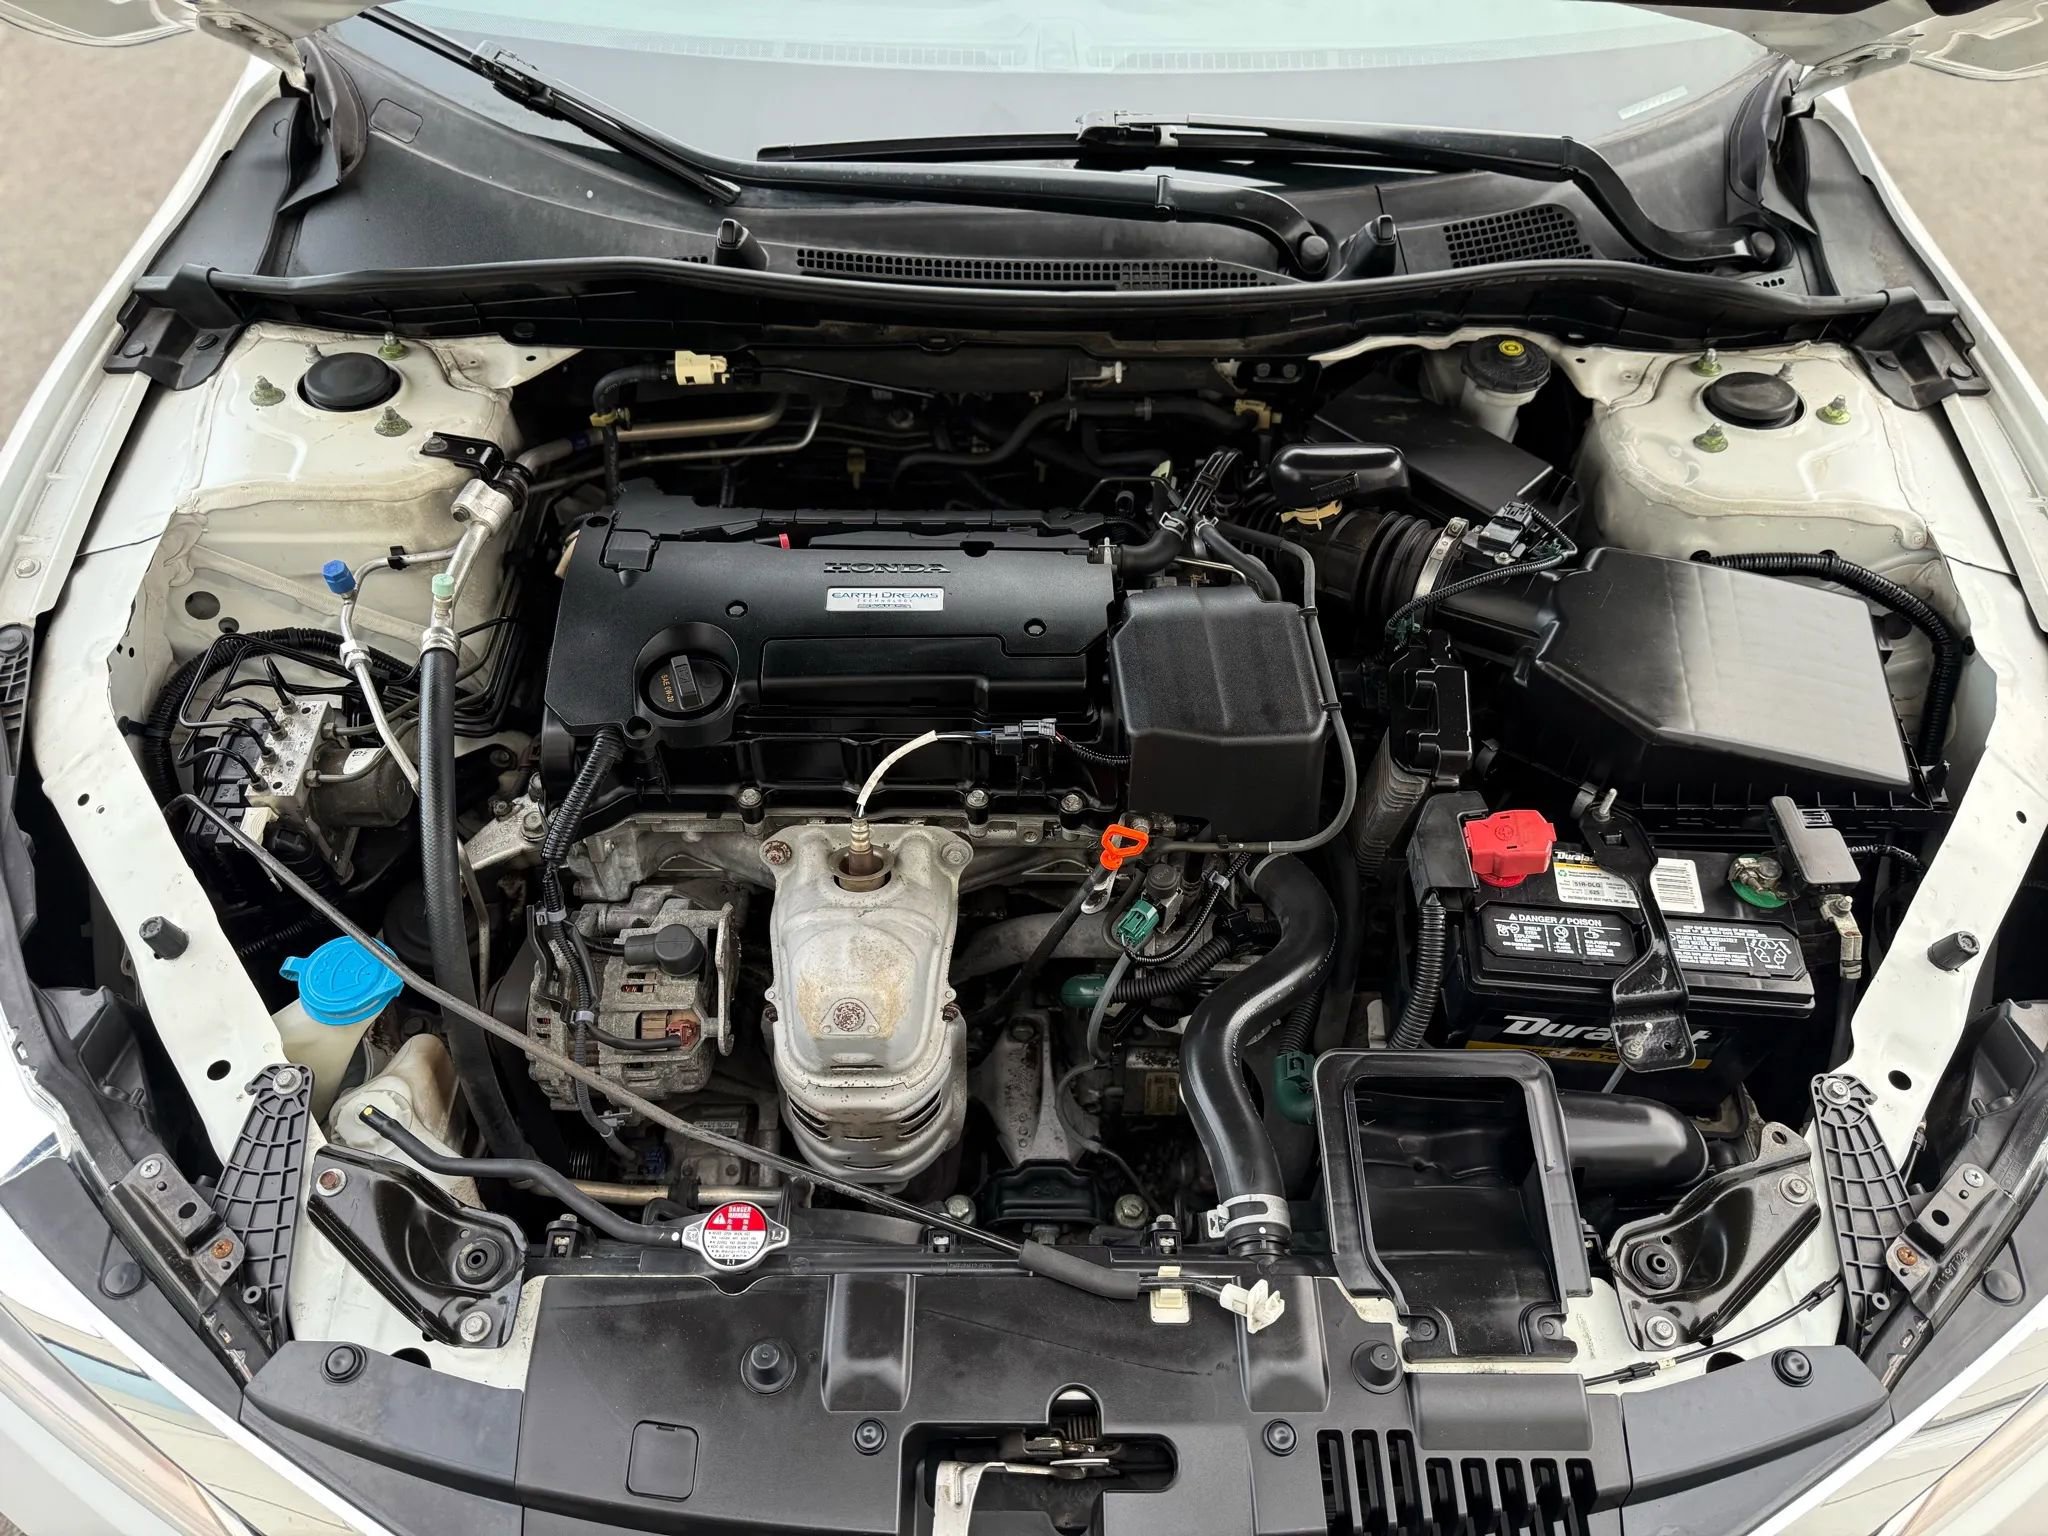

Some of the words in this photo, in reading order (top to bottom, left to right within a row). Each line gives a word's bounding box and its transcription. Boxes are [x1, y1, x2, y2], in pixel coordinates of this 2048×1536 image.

[823, 562, 951, 574] HONDA
[881, 591, 939, 599] DREAMS
[660, 674, 671, 687] SAE
[1554, 851, 1595, 863] Durala
[1518, 913, 1558, 924] DANGER
[1566, 917, 1603, 927] POISON
